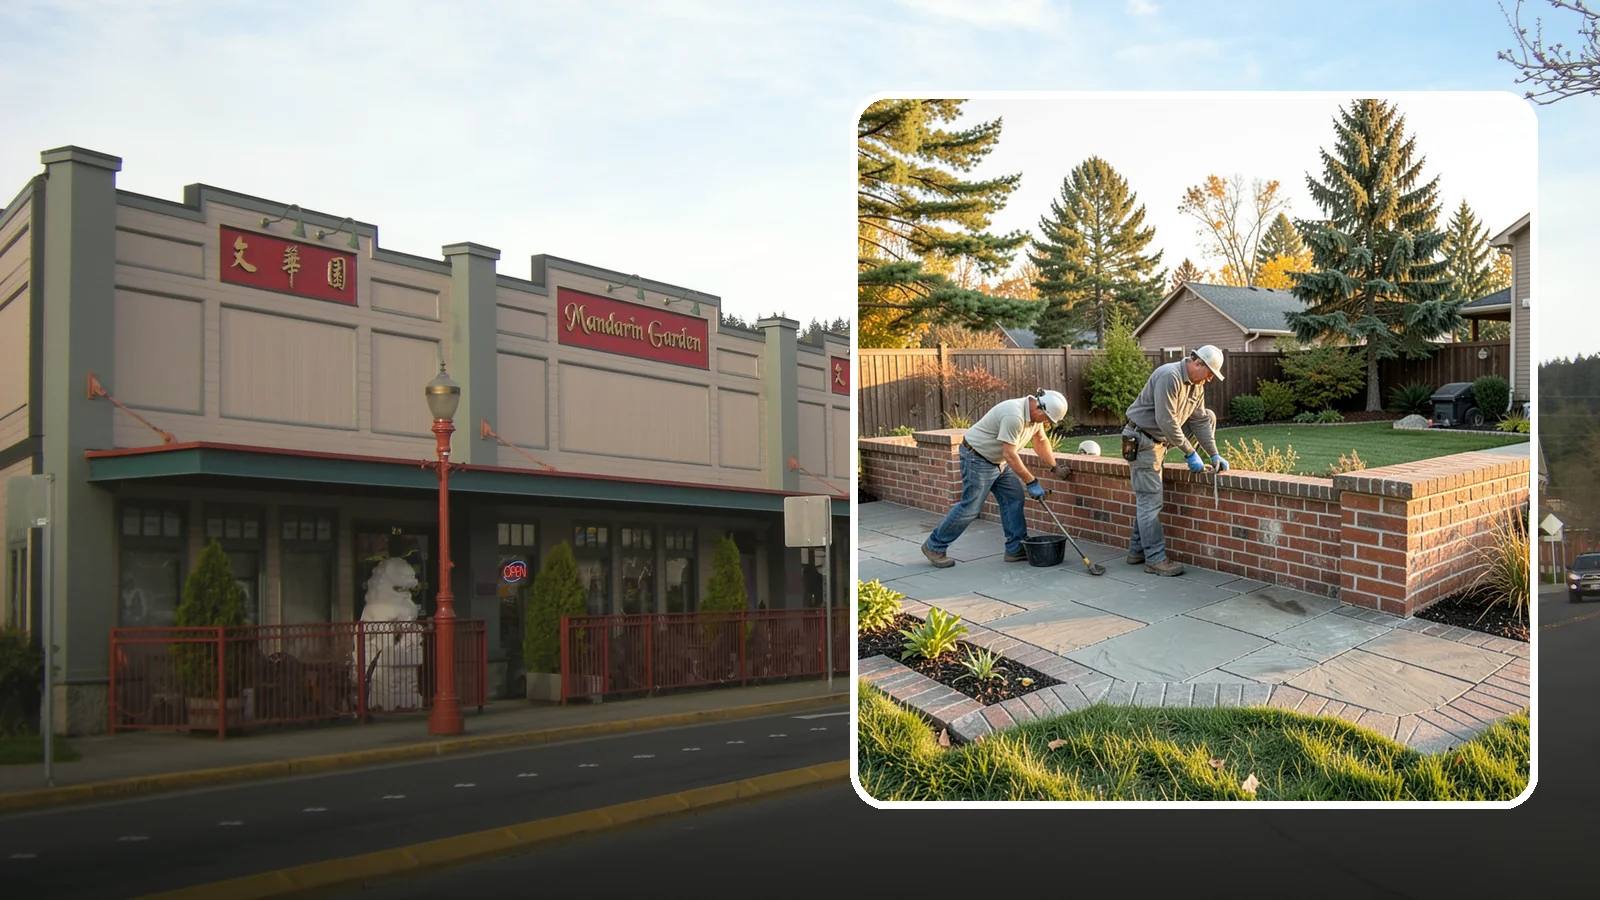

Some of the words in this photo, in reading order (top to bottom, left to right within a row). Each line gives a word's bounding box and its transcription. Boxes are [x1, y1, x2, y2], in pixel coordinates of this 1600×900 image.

[231, 235, 346, 291] 文華園
[564, 302, 644, 341] Mandarin
[648, 320, 701, 352] Garden
[503, 565, 527, 578] OPEN
